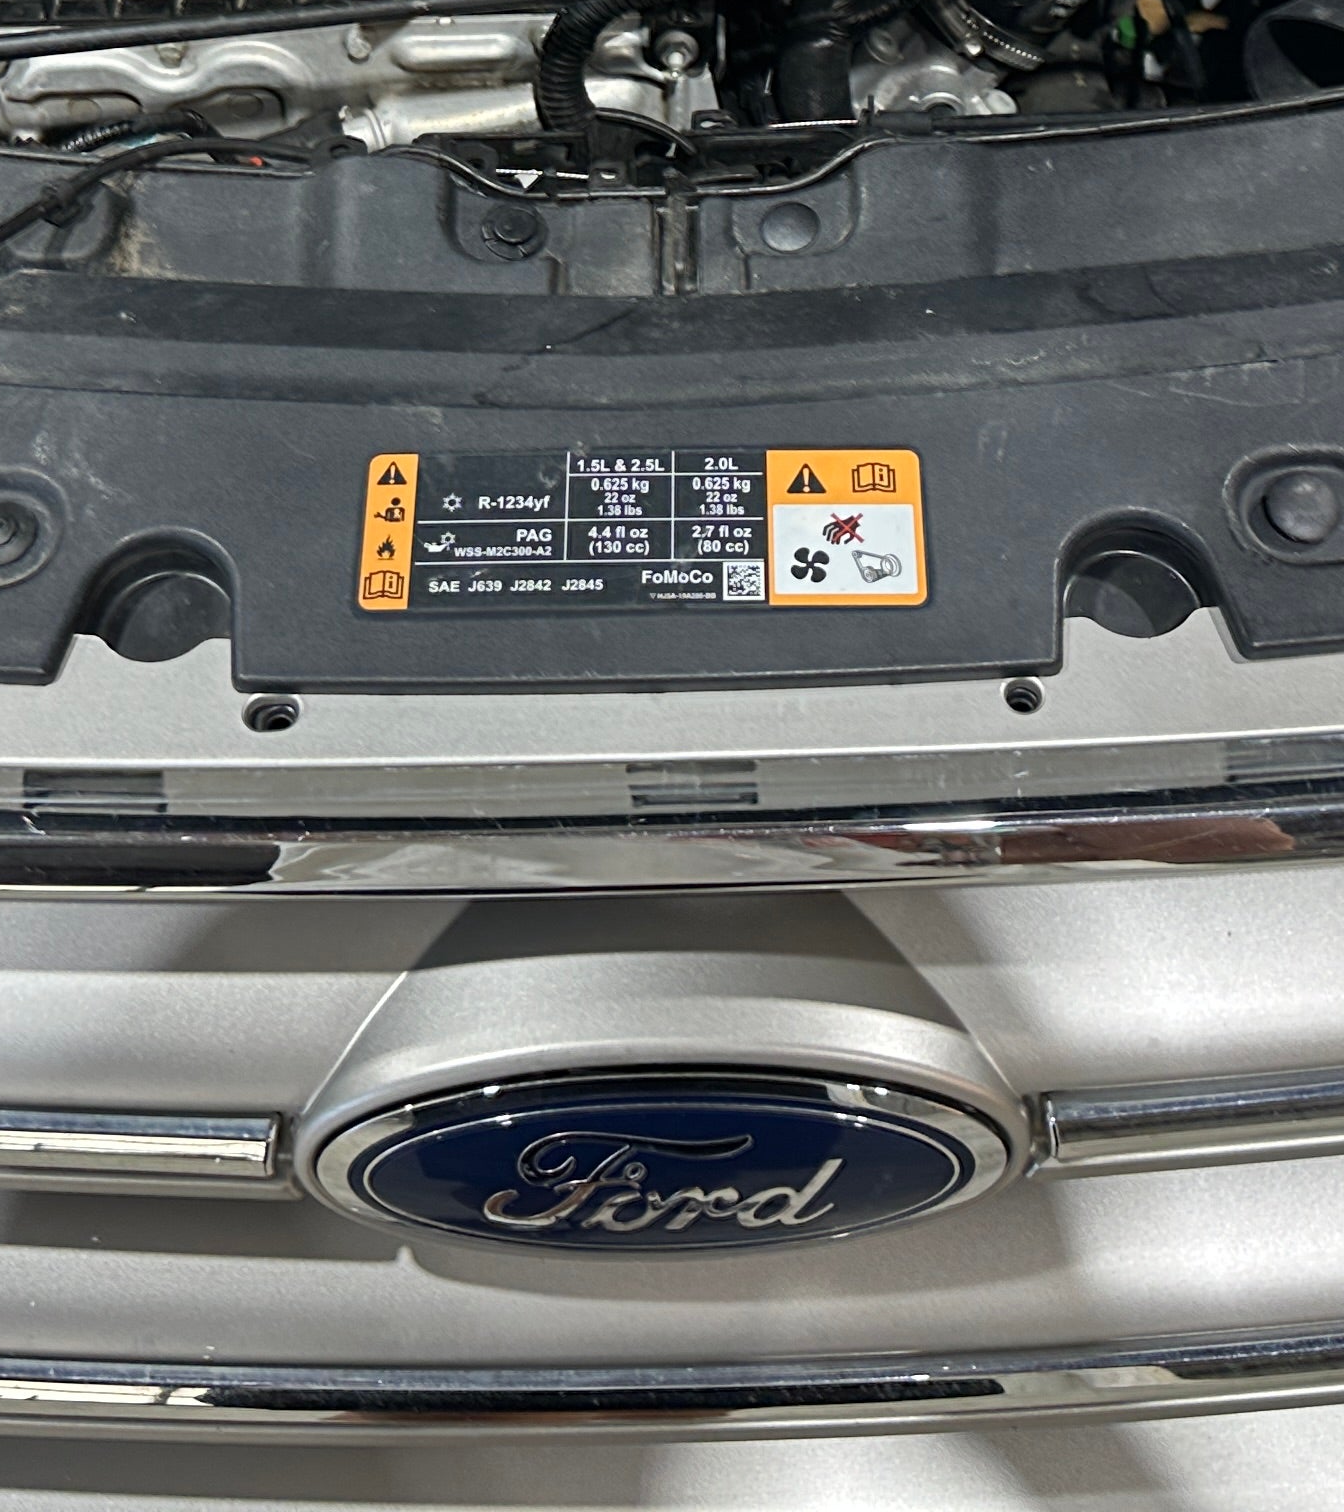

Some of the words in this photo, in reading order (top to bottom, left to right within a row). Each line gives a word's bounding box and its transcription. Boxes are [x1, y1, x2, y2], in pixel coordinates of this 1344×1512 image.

[577, 459, 610, 472] 1.5L
[614, 459, 627, 472] &
[631, 458, 665, 472] 2.5L
[704, 457, 739, 471] 2.0L
[590, 477, 629, 491] 0.625
[631, 478, 650, 494] kg
[692, 477, 730, 490] 0.625
[733, 477, 751, 493] kg
[478, 495, 551, 512] R-1234yf
[604, 492, 619, 503] 22
[621, 494, 636, 503] oz
[706, 492, 721, 503] 22
[723, 494, 738, 503] oz
[597, 505, 622, 516] 1.38
[624, 504, 643, 516] lbs
[699, 504, 724, 515] 1.38
[726, 504, 745, 515] lbs
[516, 528, 552, 542] PAG
[588, 526, 612, 539] 4.4
[615, 525, 626, 538] fl
[629, 528, 649, 539] oz
[691, 525, 715, 538] 2.7
[718, 525, 729, 538] fl
[733, 527, 752, 538] oz
[454, 546, 552, 557] WSS-M2C300-A2
[588, 541, 623, 556] (130
[625, 540, 650, 556] cc)
[697, 540, 722, 555] (80
[725, 539, 750, 555] cc)
[641, 569, 714, 584] FoMoCo
[428, 580, 461, 593] SAE
[468, 580, 503, 592] J639
[510, 579, 552, 592] J2842
[561, 579, 604, 591] J2845
[482, 1130, 845, 1232] Ford
